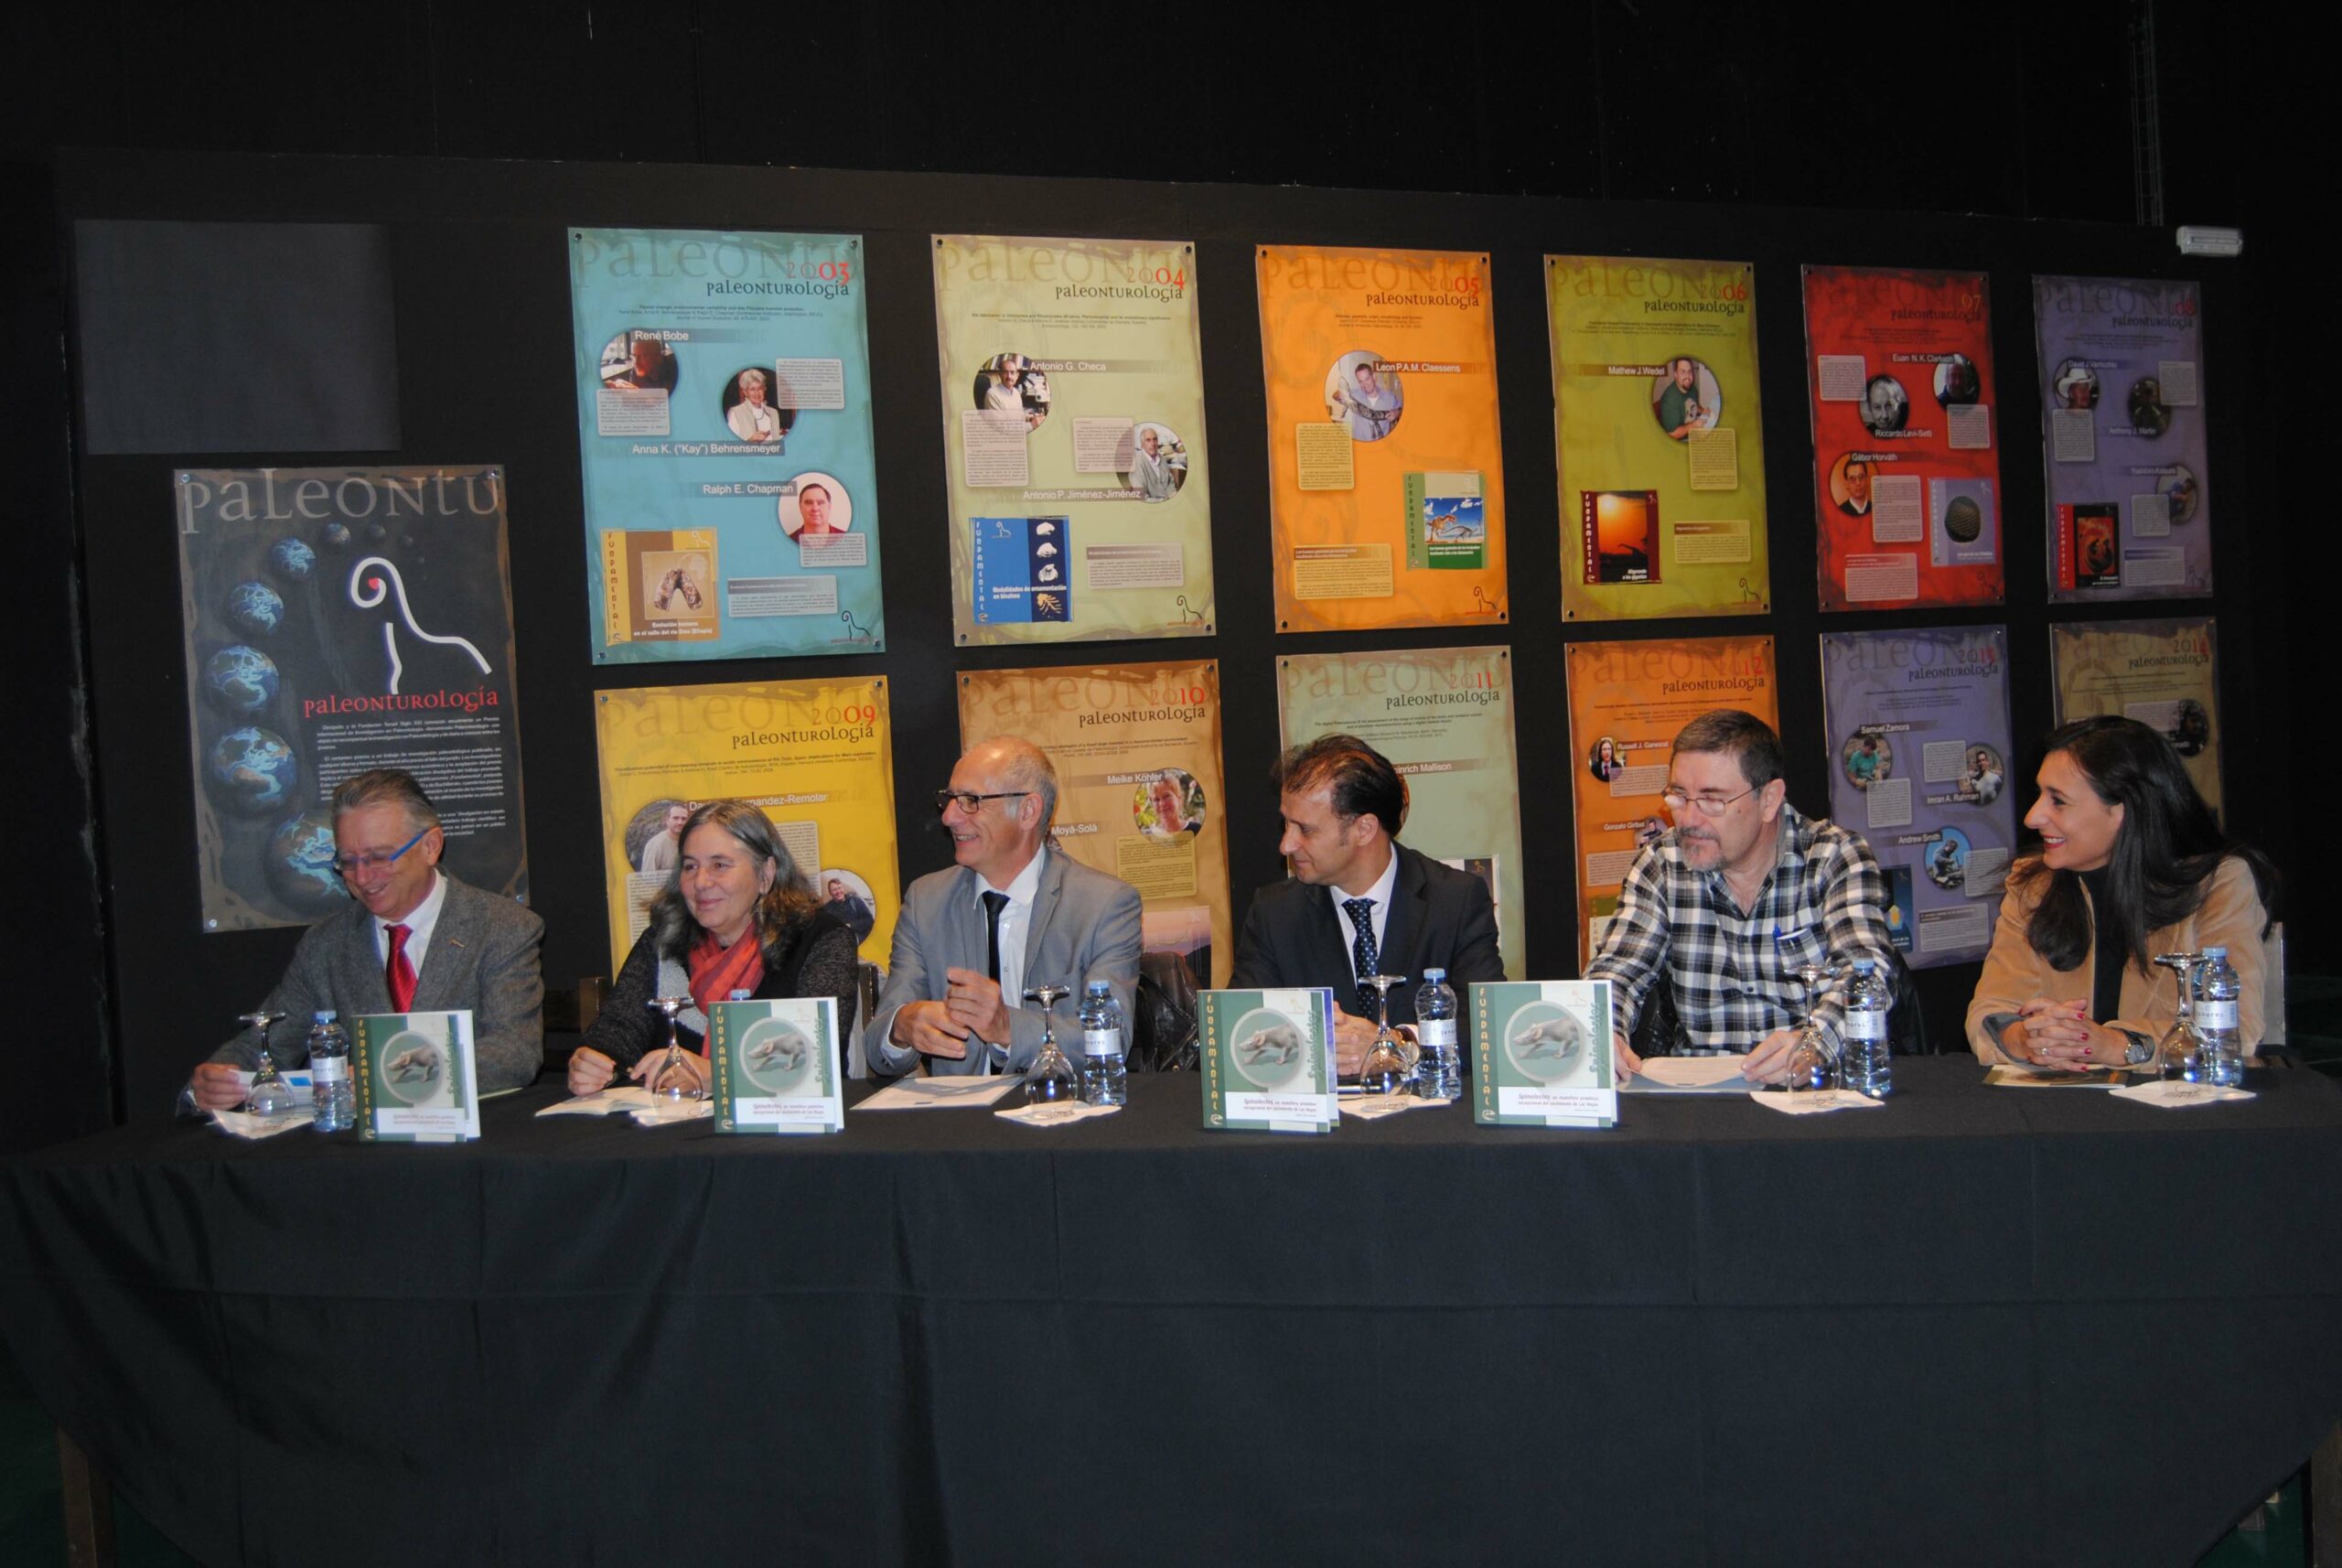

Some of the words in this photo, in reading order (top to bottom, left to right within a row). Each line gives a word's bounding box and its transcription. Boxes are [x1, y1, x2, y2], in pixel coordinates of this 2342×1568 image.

[635, 330, 661, 341] René
[663, 330, 689, 341] Bobe
[1030, 360, 1062, 371] Antonio
[1078, 361, 1106, 371] Checa
[1376, 363, 1396, 372] Leon
[1422, 363, 1461, 372] Claessens
[1608, 366, 1636, 375] Mathew
[1641, 366, 1665, 376] Wedel
[632, 445, 659, 455] Anna
[661, 445, 671, 455] K.
[711, 444, 780, 456] Behrensmeyer
[703, 485, 732, 496] Ralph
[735, 485, 745, 494] E.
[747, 484, 793, 496] Chapman
[1024, 490, 1056, 500] Antonio
[1057, 489, 1065, 499] P.
[1420, 761, 1452, 772] Mallison
[1107, 774, 1133, 785] Meike
